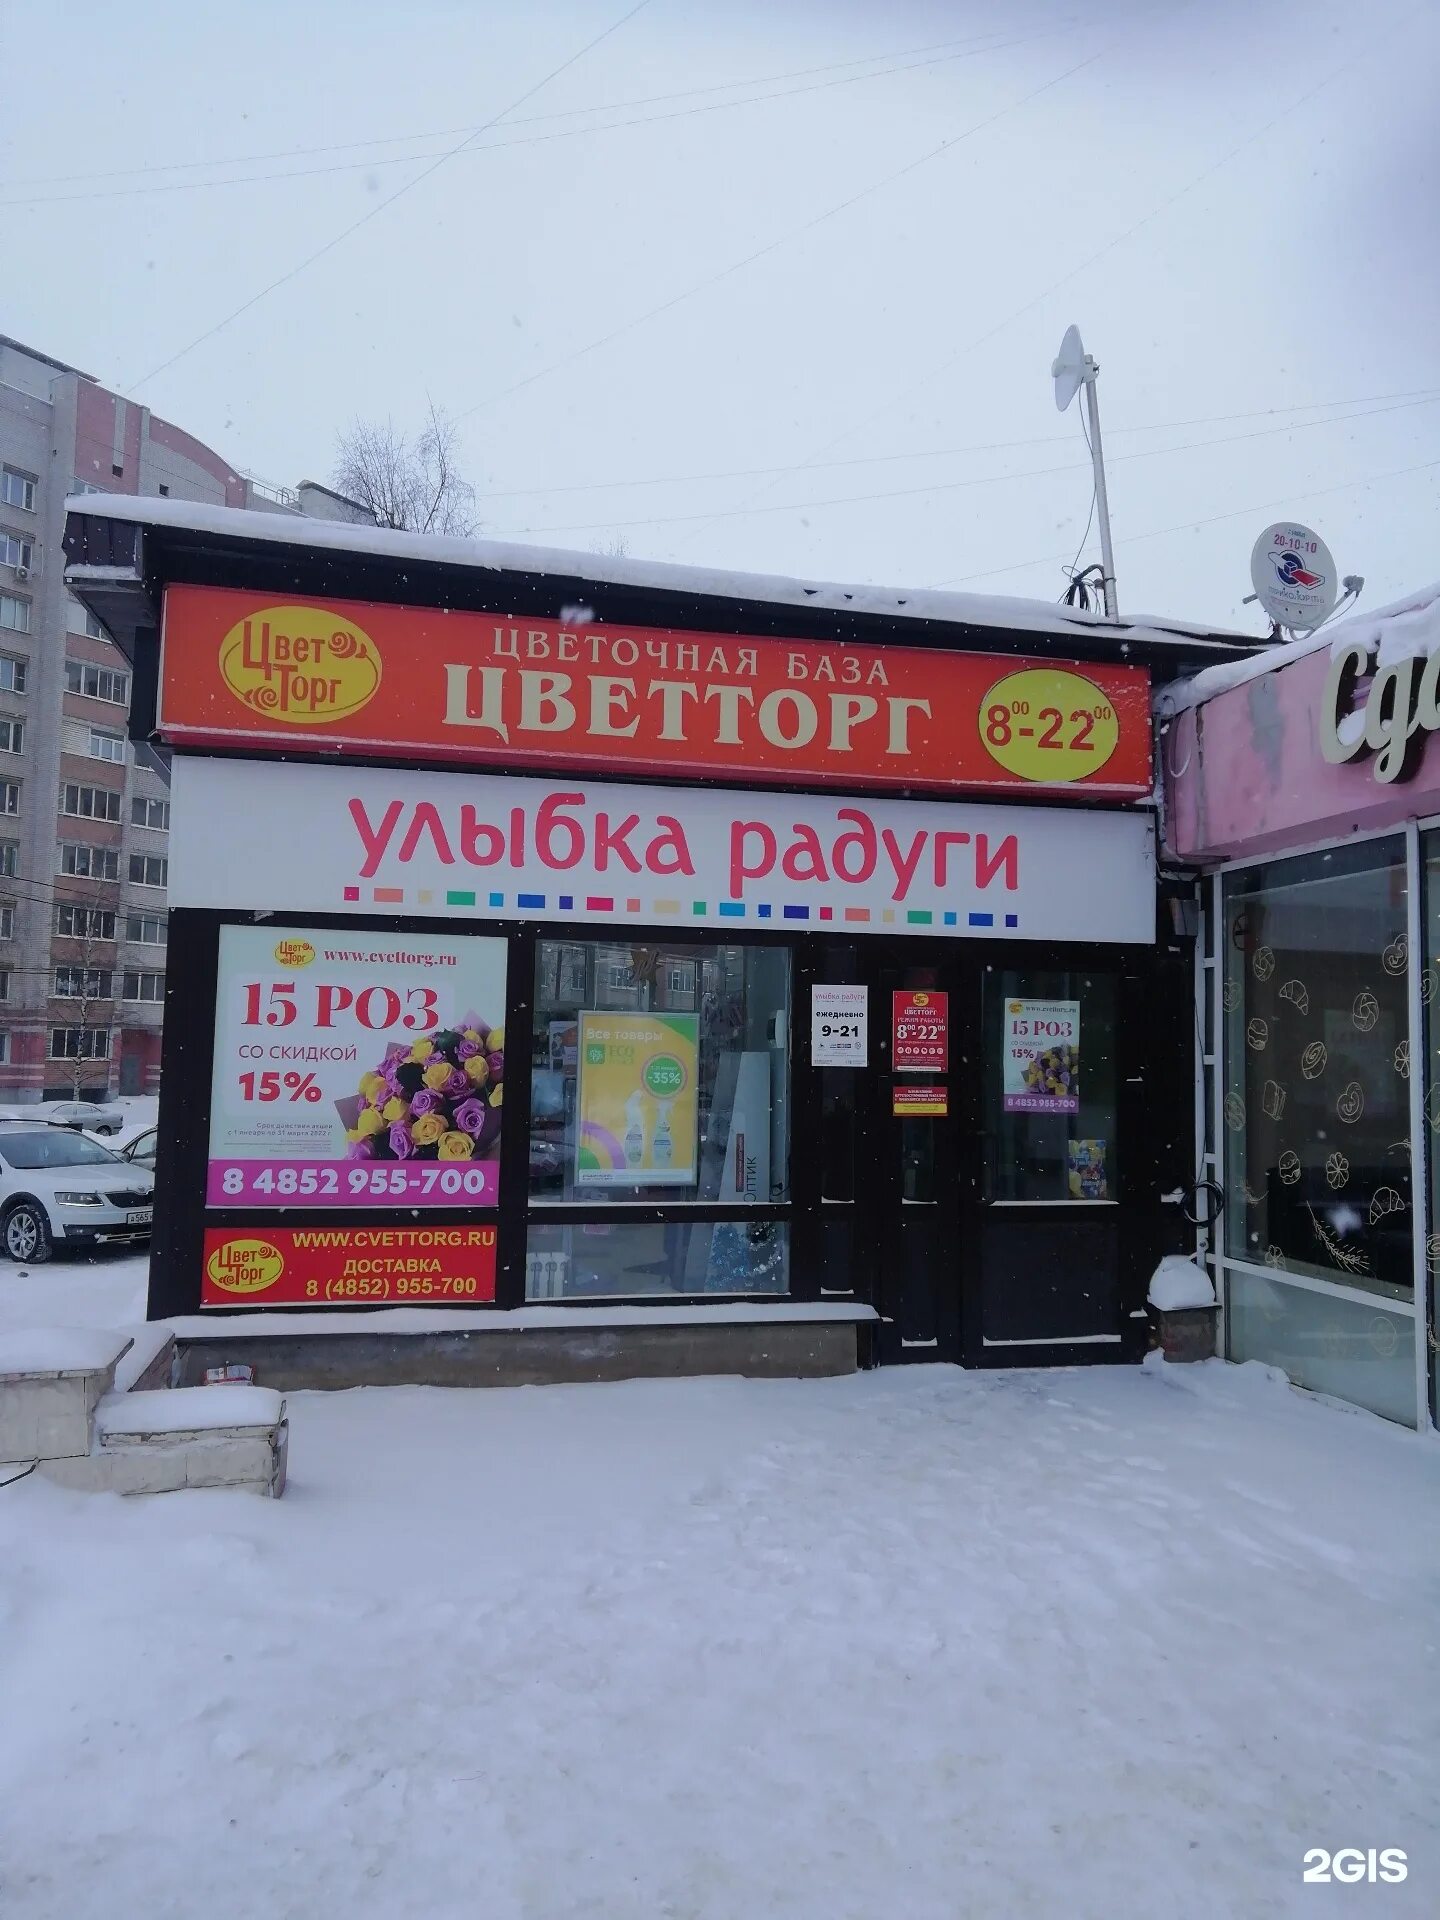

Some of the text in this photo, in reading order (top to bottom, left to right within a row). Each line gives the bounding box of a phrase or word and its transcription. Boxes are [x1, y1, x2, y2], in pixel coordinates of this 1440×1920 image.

[1274, 533, 1317, 553] 20-10-10
[242, 620, 326, 680] Цвет
[493, 627, 890, 686] ЦВЕТОЧНАЯ БАЗА
[272, 664, 342, 712] Торг
[442, 662, 933, 755] ЦВЕТТОРГ
[348, 792, 1019, 902] улыбка радуги
[240, 981, 440, 1031] 15 РОЗ
[815, 1011, 864, 1019] ежедневно
[586, 1028, 665, 1043] Все товары
[821, 1025, 859, 1037] 9-21
[1012, 1020, 1073, 1038] 15 РОЗ
[238, 1043, 358, 1062] СО СКИДКОЙ
[1011, 1048, 1035, 1059] 15%
[238, 1071, 323, 1103] 15%
[222, 1168, 486, 1195] 8 4852 955-700
[292, 1231, 495, 1248] WWW.CVETTORG.RU
[218, 1245, 257, 1273] Цвет
[343, 1258, 442, 1277] ДОСТАВКА
[230, 1263, 265, 1286] Торг
[305, 1277, 478, 1300] 8 (4852) 955-700
